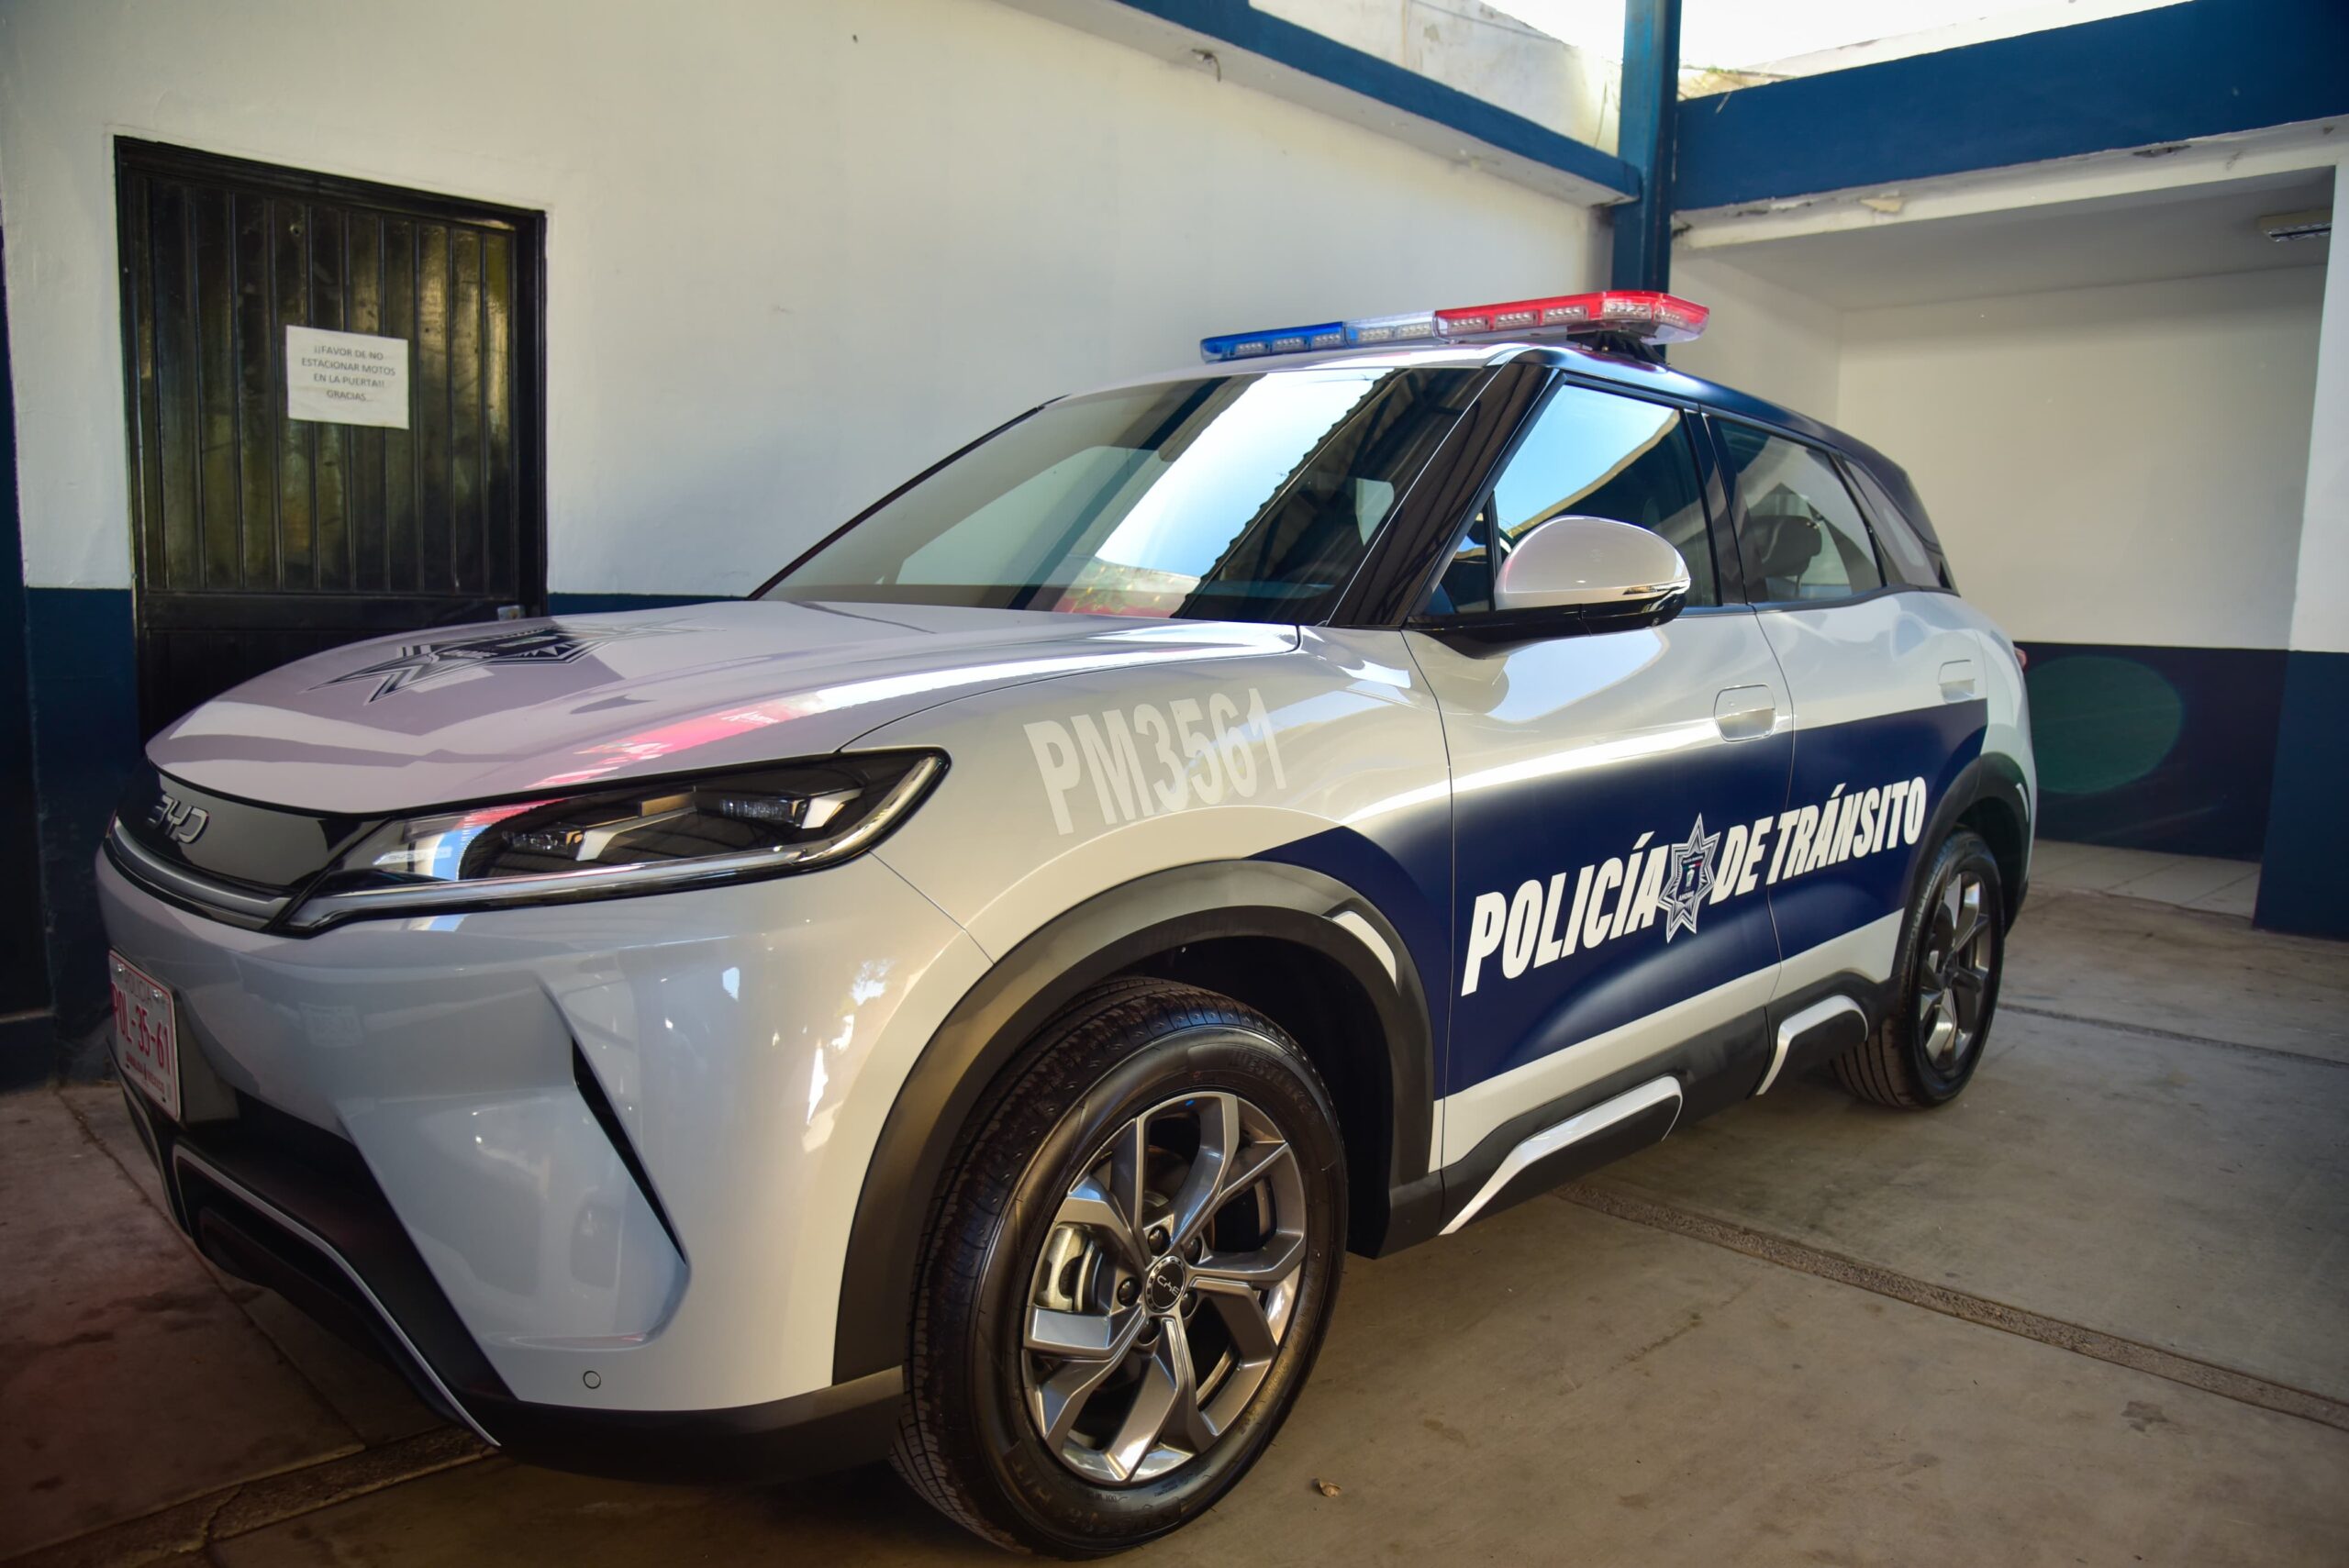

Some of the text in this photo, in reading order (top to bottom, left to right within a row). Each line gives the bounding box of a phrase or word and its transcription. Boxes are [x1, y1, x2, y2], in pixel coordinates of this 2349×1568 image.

[355, 350, 366, 359] DE
[369, 352, 384, 361] NO
[301, 357, 396, 376] ESTACIONAR MOTOS
[313, 373, 327, 383] EN
[328, 374, 340, 384] LA
[1023, 688, 1286, 836] PM3561
[1461, 776, 1927, 996] POLICÍA DE TRÁNSITO
